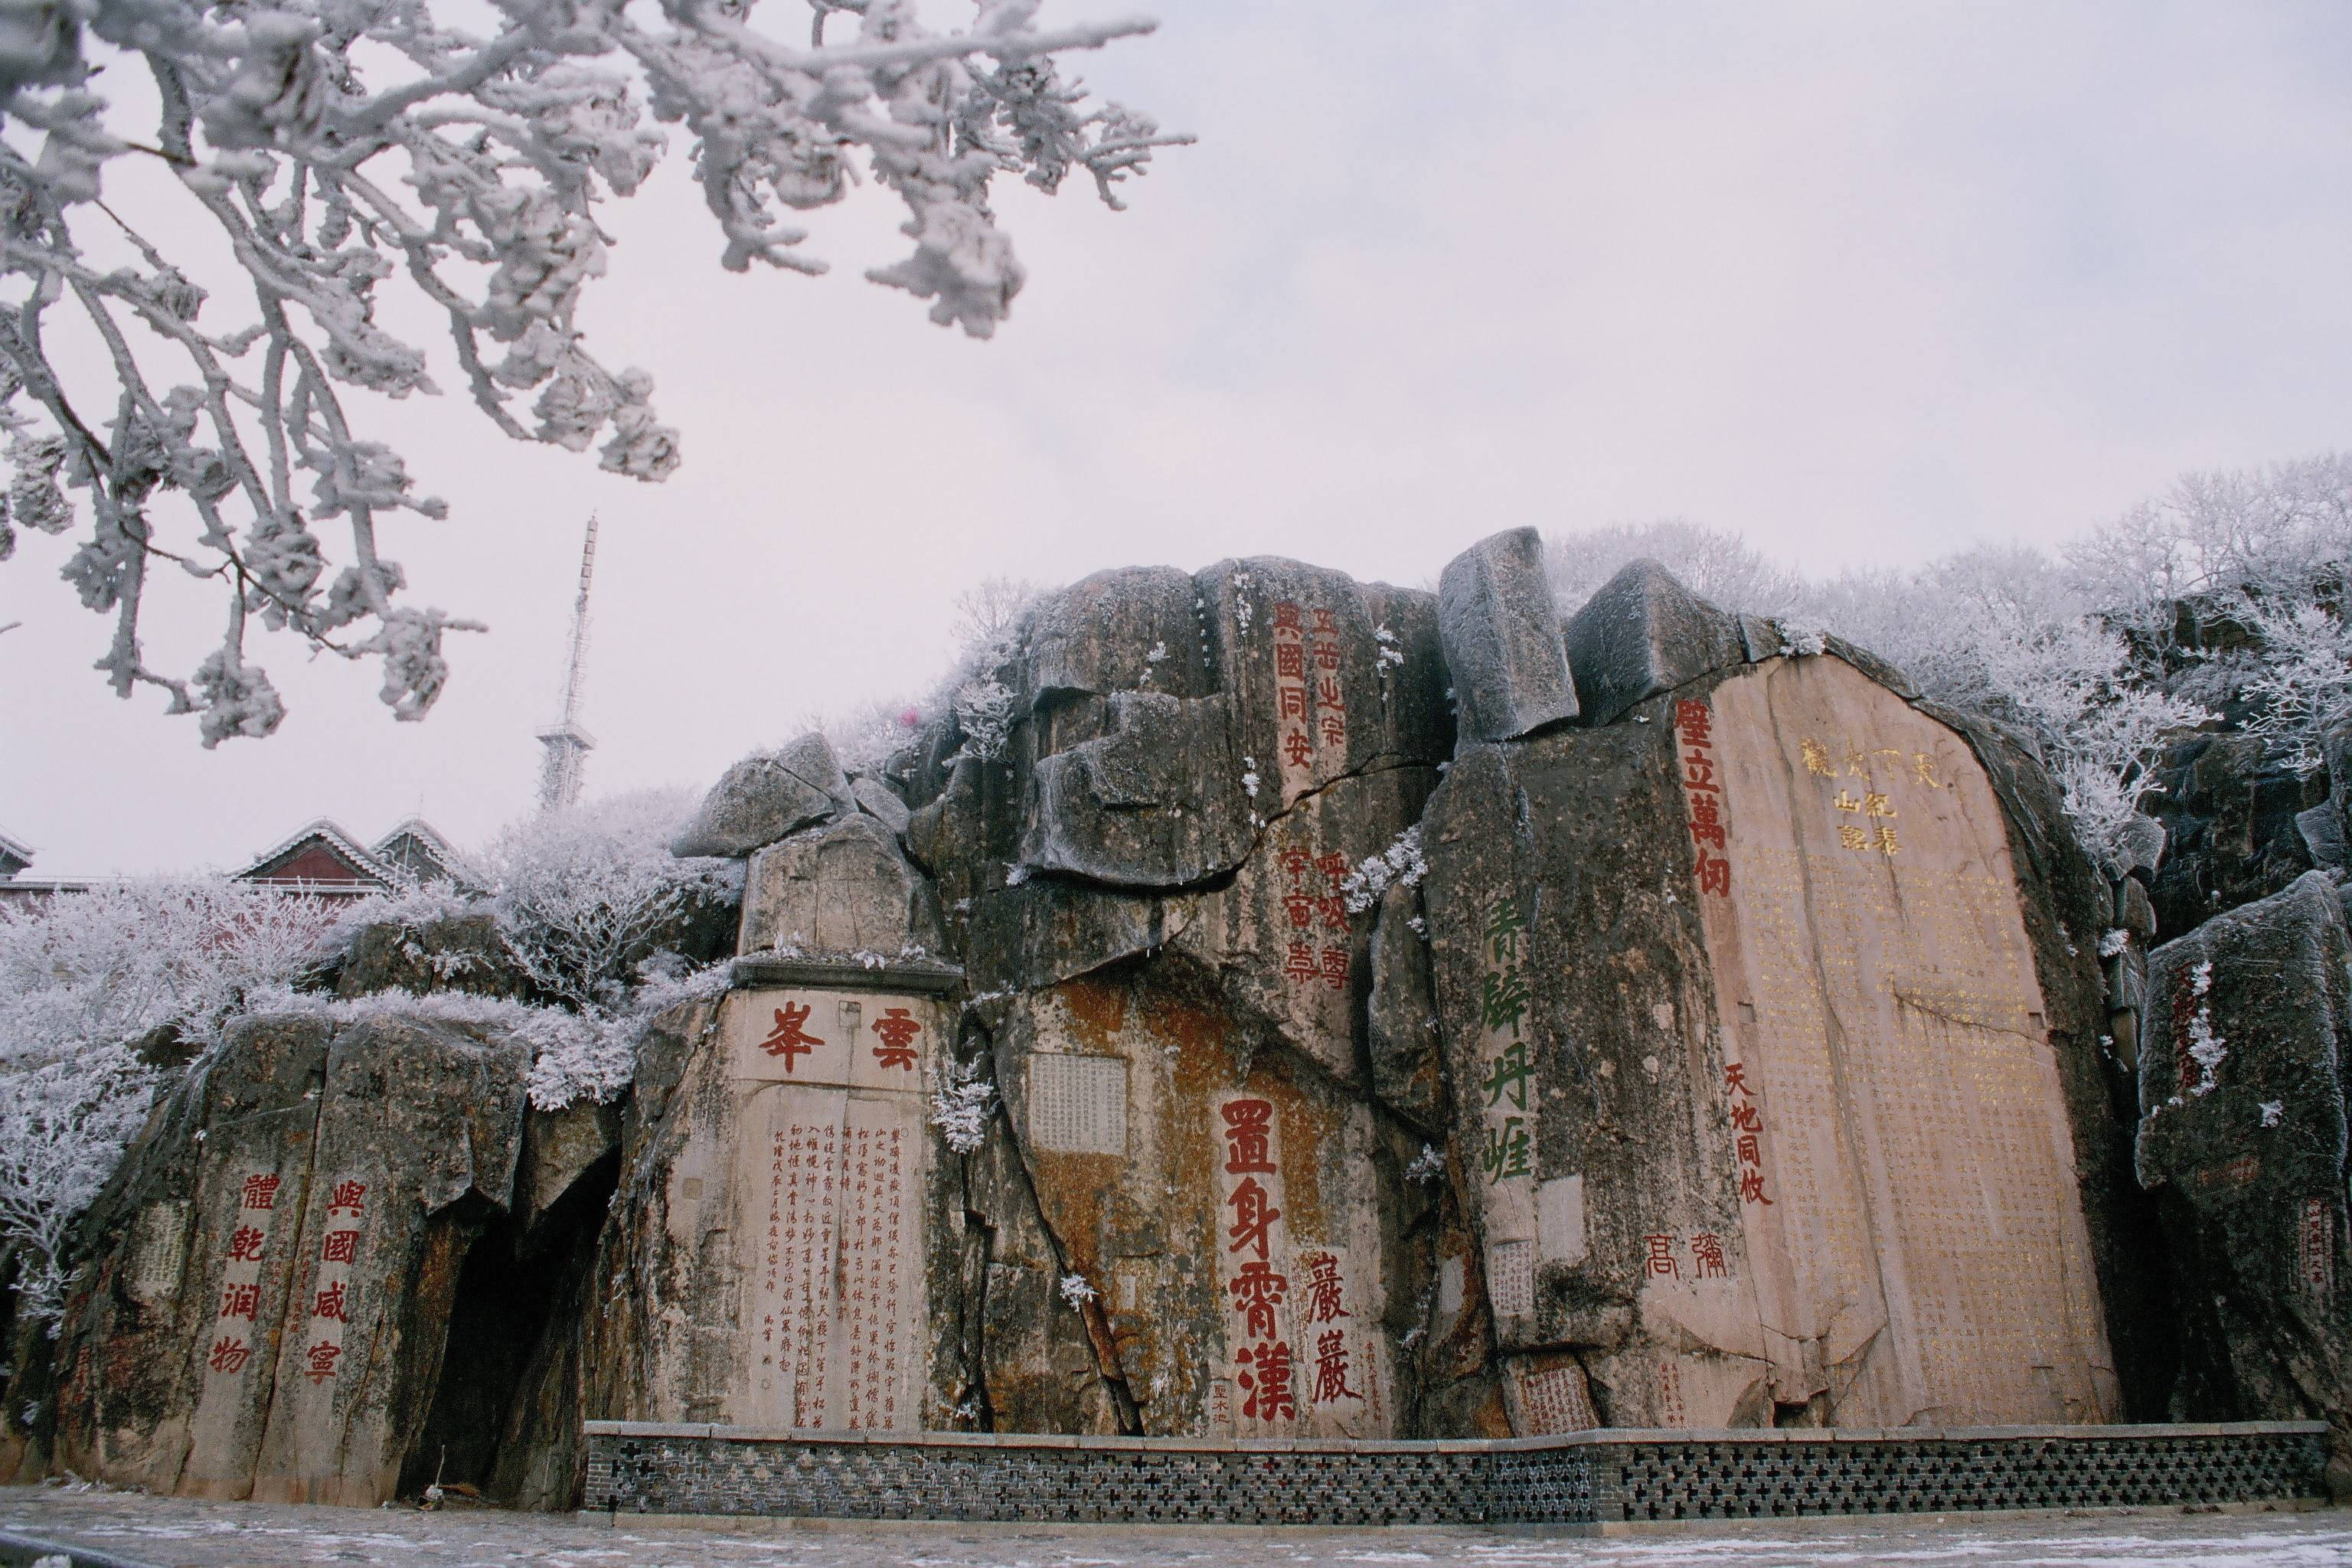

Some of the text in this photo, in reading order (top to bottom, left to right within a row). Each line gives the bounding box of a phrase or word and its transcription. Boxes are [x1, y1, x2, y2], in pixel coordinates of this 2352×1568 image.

[1674, 697, 1730, 897] 壁立萬仞
[1220, 1099, 1296, 1423] 置身霄漢
